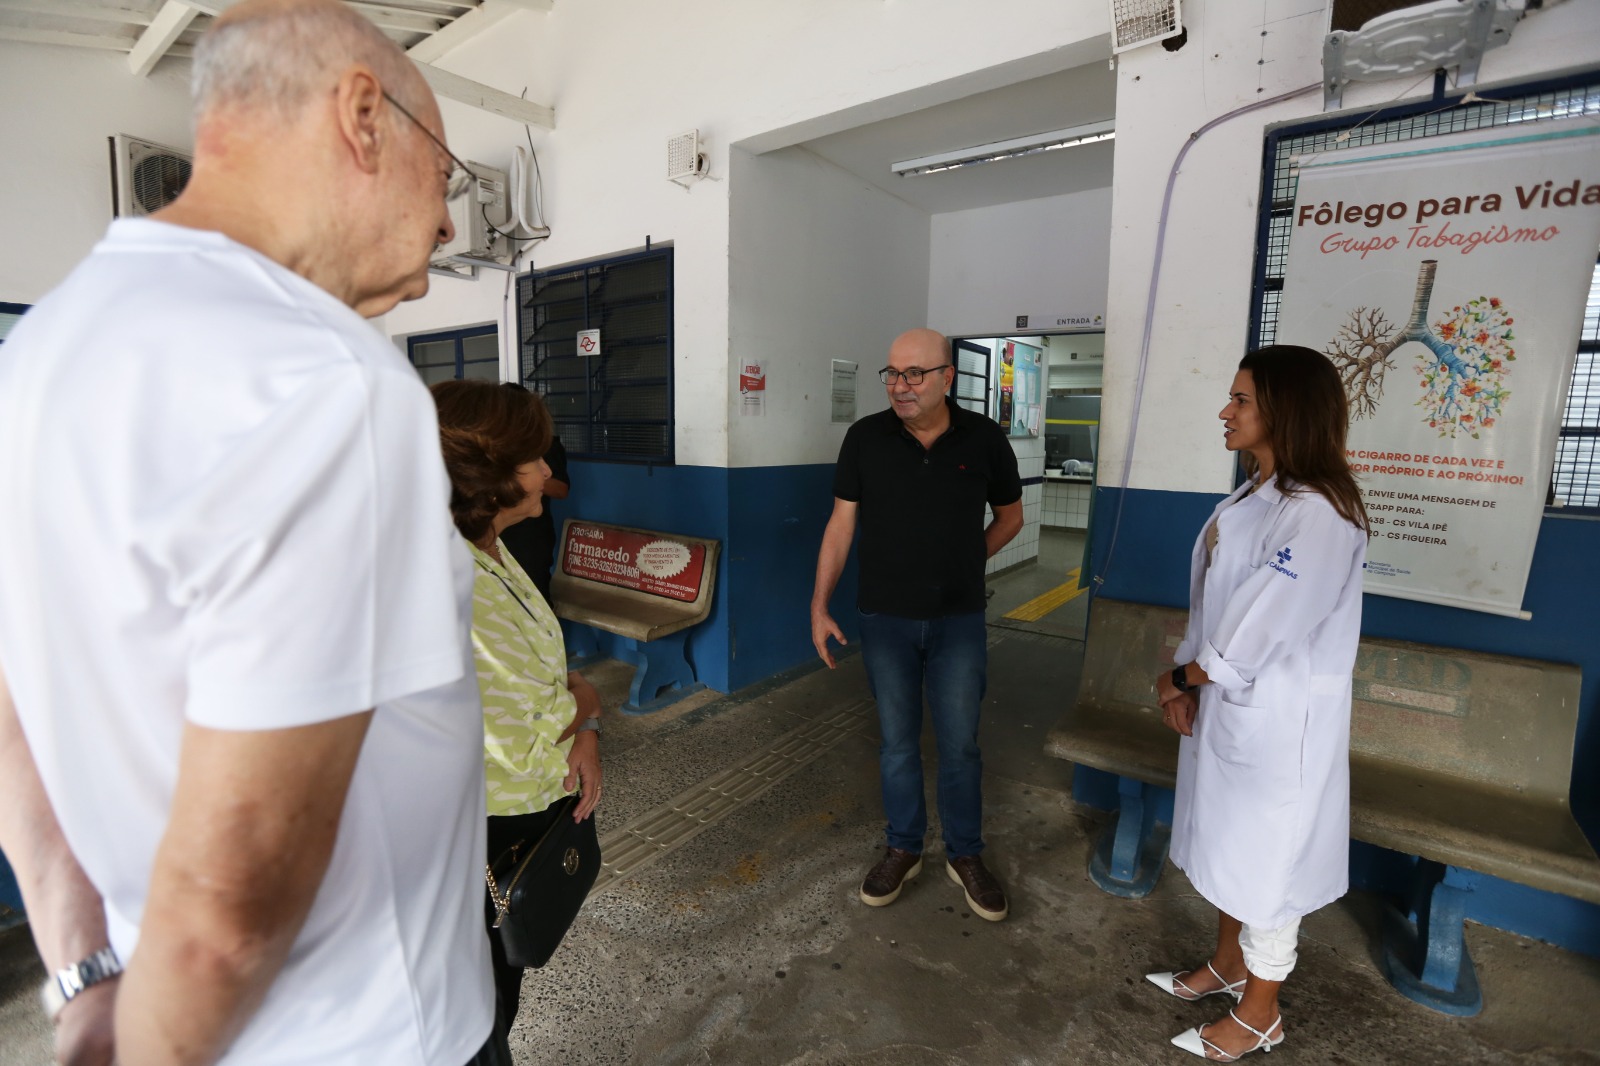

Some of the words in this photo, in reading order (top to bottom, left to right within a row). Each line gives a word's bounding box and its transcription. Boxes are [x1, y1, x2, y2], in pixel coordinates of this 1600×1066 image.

[1298, 201, 1408, 228] Fôlego
[1416, 193, 1502, 224] para
[1515, 179, 1600, 210] Vida
[1320, 232, 1400, 260] Grupo
[1407, 221, 1560, 255] Tabagismo
[1056, 317, 1090, 325] ENTRADA
[1345, 449, 1356, 458] M
[1358, 450, 1412, 462] CIGARRO
[1413, 454, 1430, 464] DE
[1432, 455, 1468, 467] CADA
[1471, 458, 1495, 468] VEZ
[1497, 460, 1505, 469] E
[1372, 464, 1425, 477] PRÓPRIO
[1427, 469, 1435, 478] E
[1436, 470, 1456, 479] AO
[1457, 471, 1524, 485] PRÓXIMO!
[1364, 502, 1395, 512] TSAPP
[1396, 506, 1425, 516] PARA:
[1368, 489, 1396, 499] ENVIE
[1397, 492, 1420, 501] UMA
[1421, 494, 1480, 507] MENSAGEM
[1482, 500, 1497, 509] DE
[1368, 516, 1385, 525] 438
[1392, 519, 1406, 527] CS
[1408, 521, 1430, 530] VILA
[1431, 522, 1448, 532] IPÊ
[1387, 532, 1400, 540] CS
[1402, 533, 1447, 546] FIGUEIRA
[568, 538, 630, 563] farmacedo
[1269, 561, 1298, 580] CAMPINAS
[1357, 649, 1472, 692] MED
